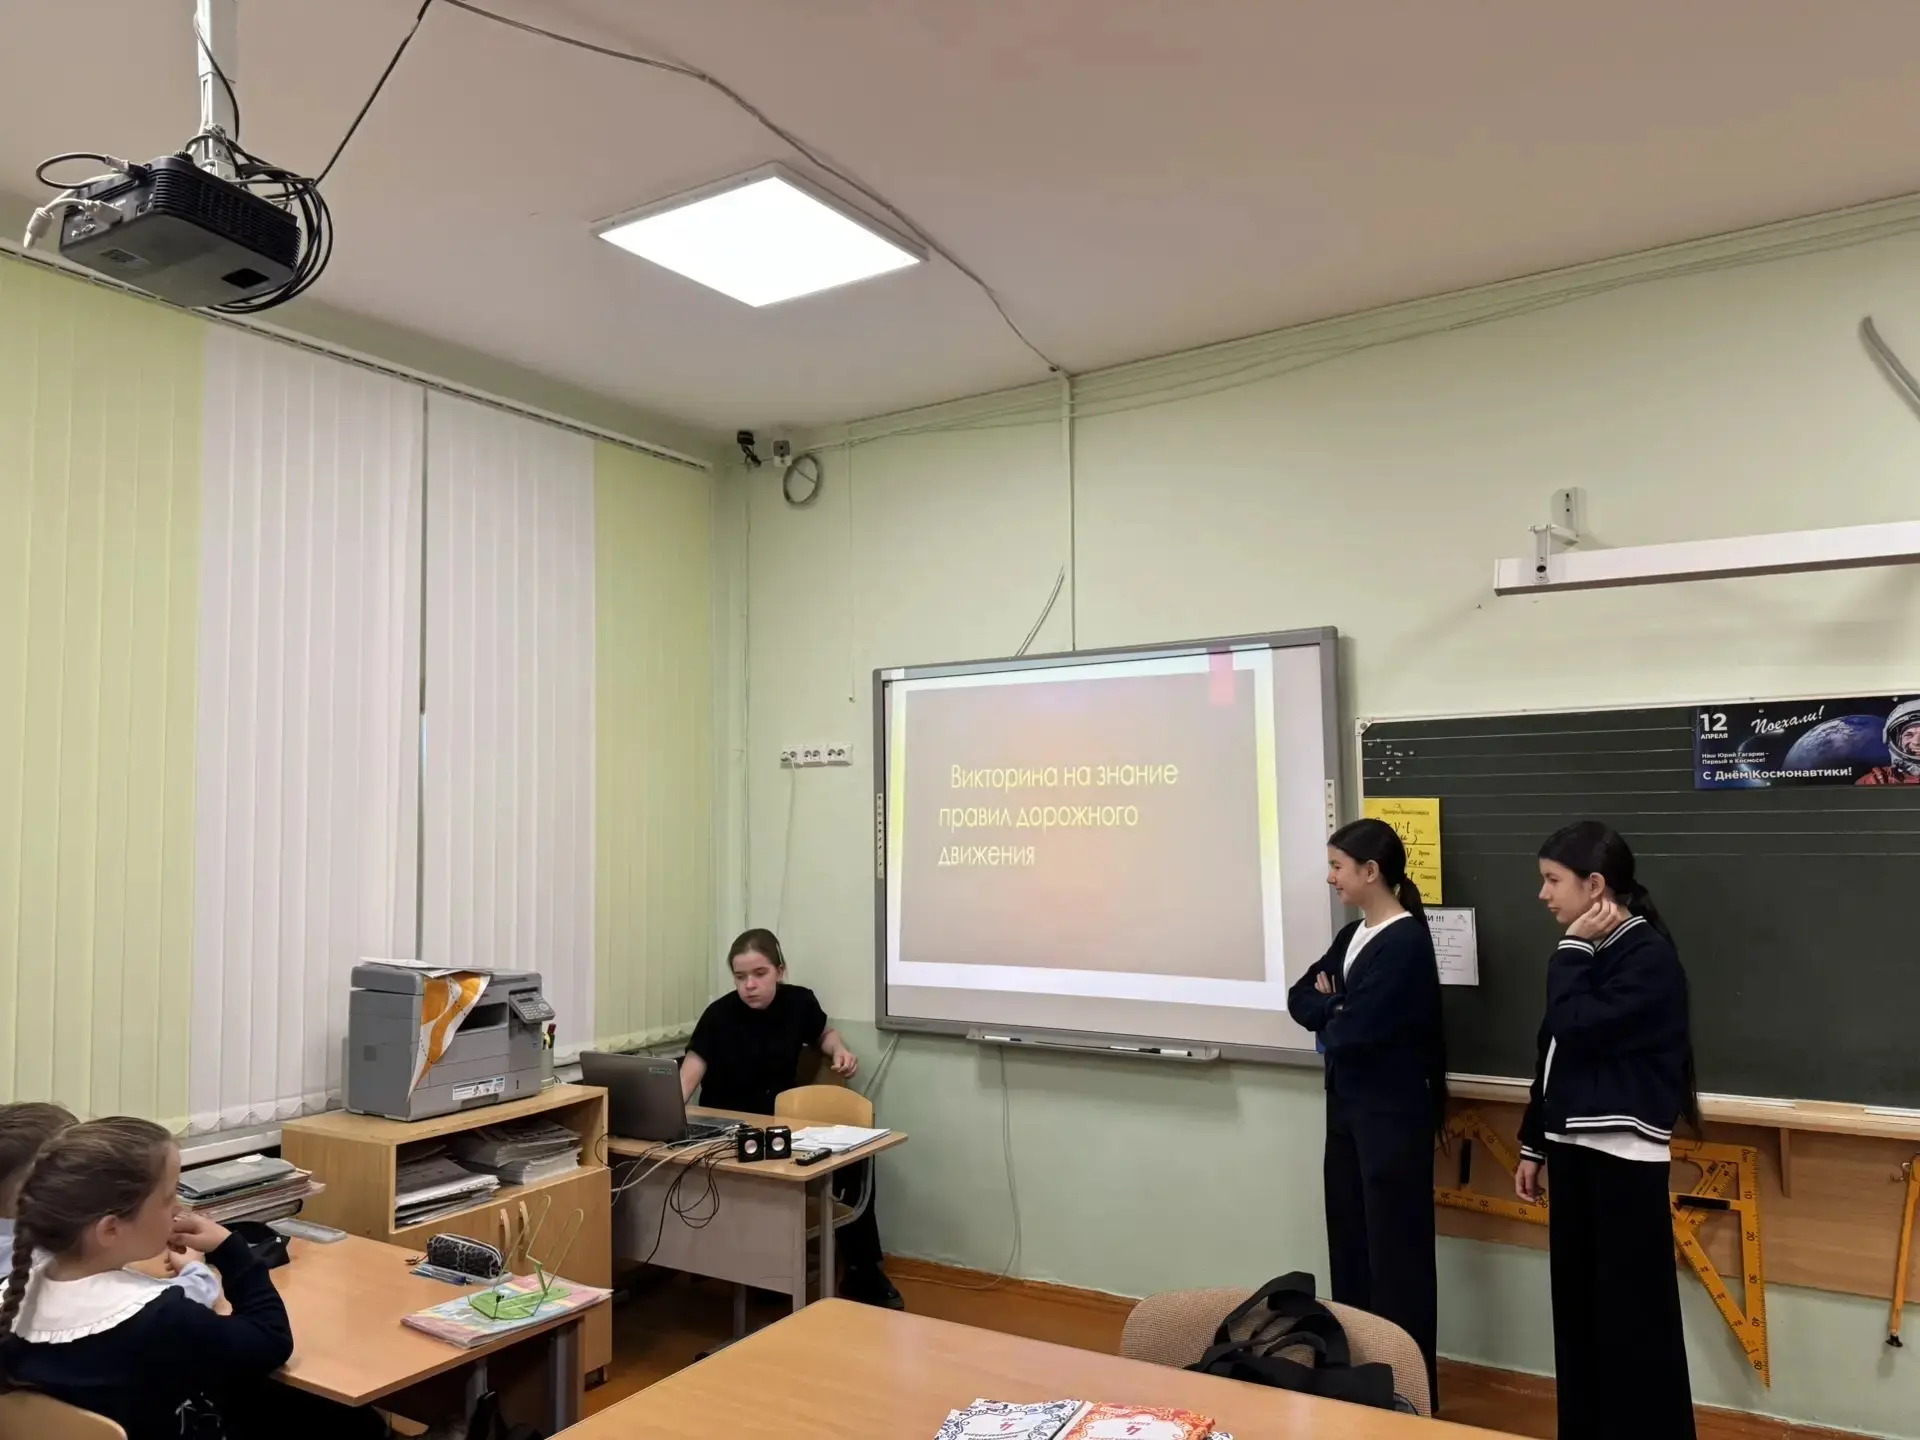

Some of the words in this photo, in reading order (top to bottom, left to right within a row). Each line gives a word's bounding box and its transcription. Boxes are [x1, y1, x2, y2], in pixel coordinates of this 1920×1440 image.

[1700, 713, 1728, 732] 12
[1751, 705, 1825, 734] Поехали!
[1734, 757, 1766, 765] Космосе!
[952, 764, 1058, 792] Викторина
[1064, 766, 1091, 787] на
[1096, 763, 1180, 787] знание
[1702, 771, 1712, 780] С
[1715, 770, 1748, 782] Днём
[1752, 766, 1853, 780] Космонавтики!
[939, 806, 1012, 833] правил
[1016, 804, 1139, 833] дорожного
[937, 846, 1036, 866] движения
[1744, 1190, 1753, 1200] 10
[1518, 1207, 1527, 1216] 10
[1746, 1231, 1755, 1242] 20
[1748, 1273, 1758, 1284] 30
[1751, 1316, 1760, 1327] 40
[1753, 1360, 1762, 1370] 50
[1000, 1420, 1016, 1431] 4
[1125, 1424, 1142, 1435] 4
